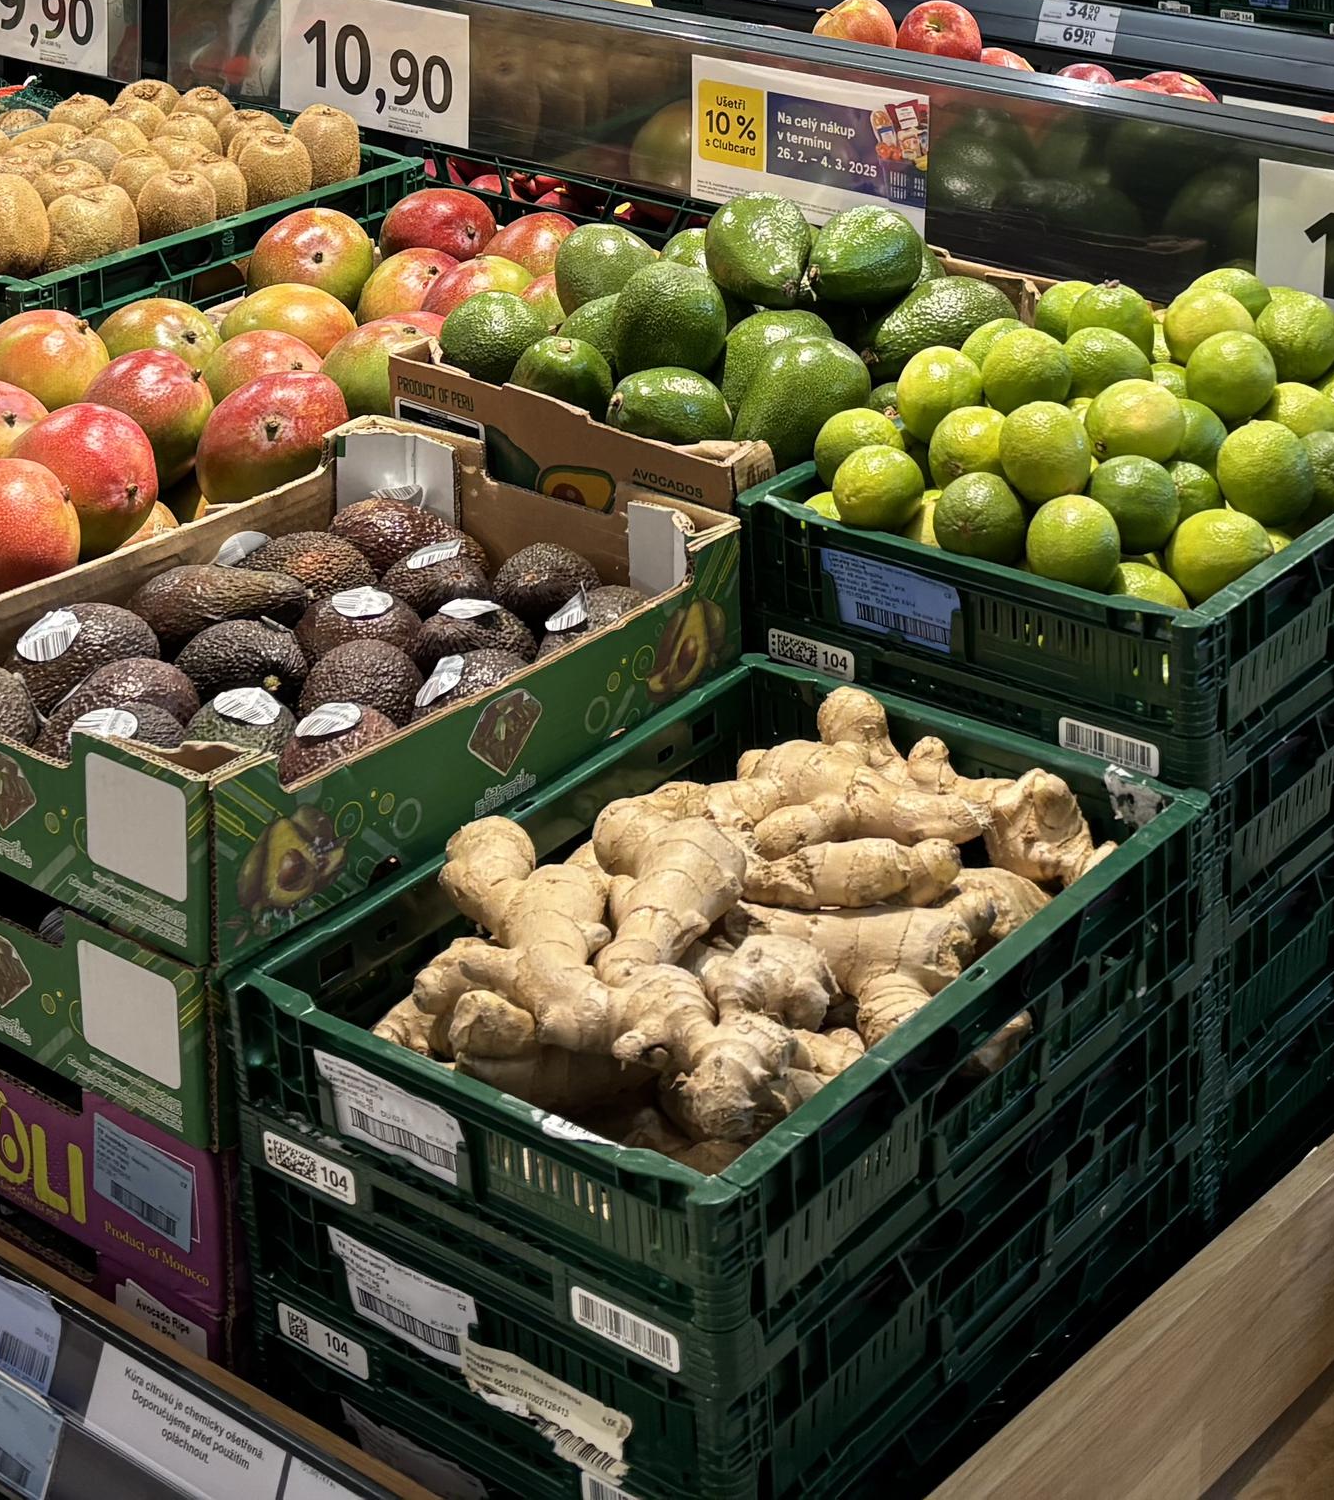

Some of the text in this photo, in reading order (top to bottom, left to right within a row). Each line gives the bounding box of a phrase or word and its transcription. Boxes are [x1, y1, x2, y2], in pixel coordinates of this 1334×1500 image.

[1066, 2, 1089, 18] 34
[1062, 26, 1085, 43] 69
[303, 19, 453, 115] 10,90
[716, 94, 746, 112] Ušetři
[705, 109, 756, 141] 10 %
[777, 111, 856, 139] Na celý nákup
[777, 130, 832, 151] v termínu
[705, 138, 756, 156] s Clubcard
[777, 146, 878, 178] 26. 2. 4. 3. 2025
[397, 375, 475, 413] PRODUCT OF PERU
[632, 467, 705, 501] AVOCADOS
[822, 650, 848, 671] 104
[320, 1164, 349, 1193] 104
[104, 1219, 146, 1252] Product
[148, 1246, 161, 1261] of
[135, 1297, 191, 1336] Avocado Ripe
[323, 1329, 349, 1358] 104
[131, 1387, 251, 1471] Doporučujeme před použitím
[174, 1394, 184, 1410] je
[184, 1401, 224, 1437] chemicky
[161, 1426, 211, 1465] opláchnout.
